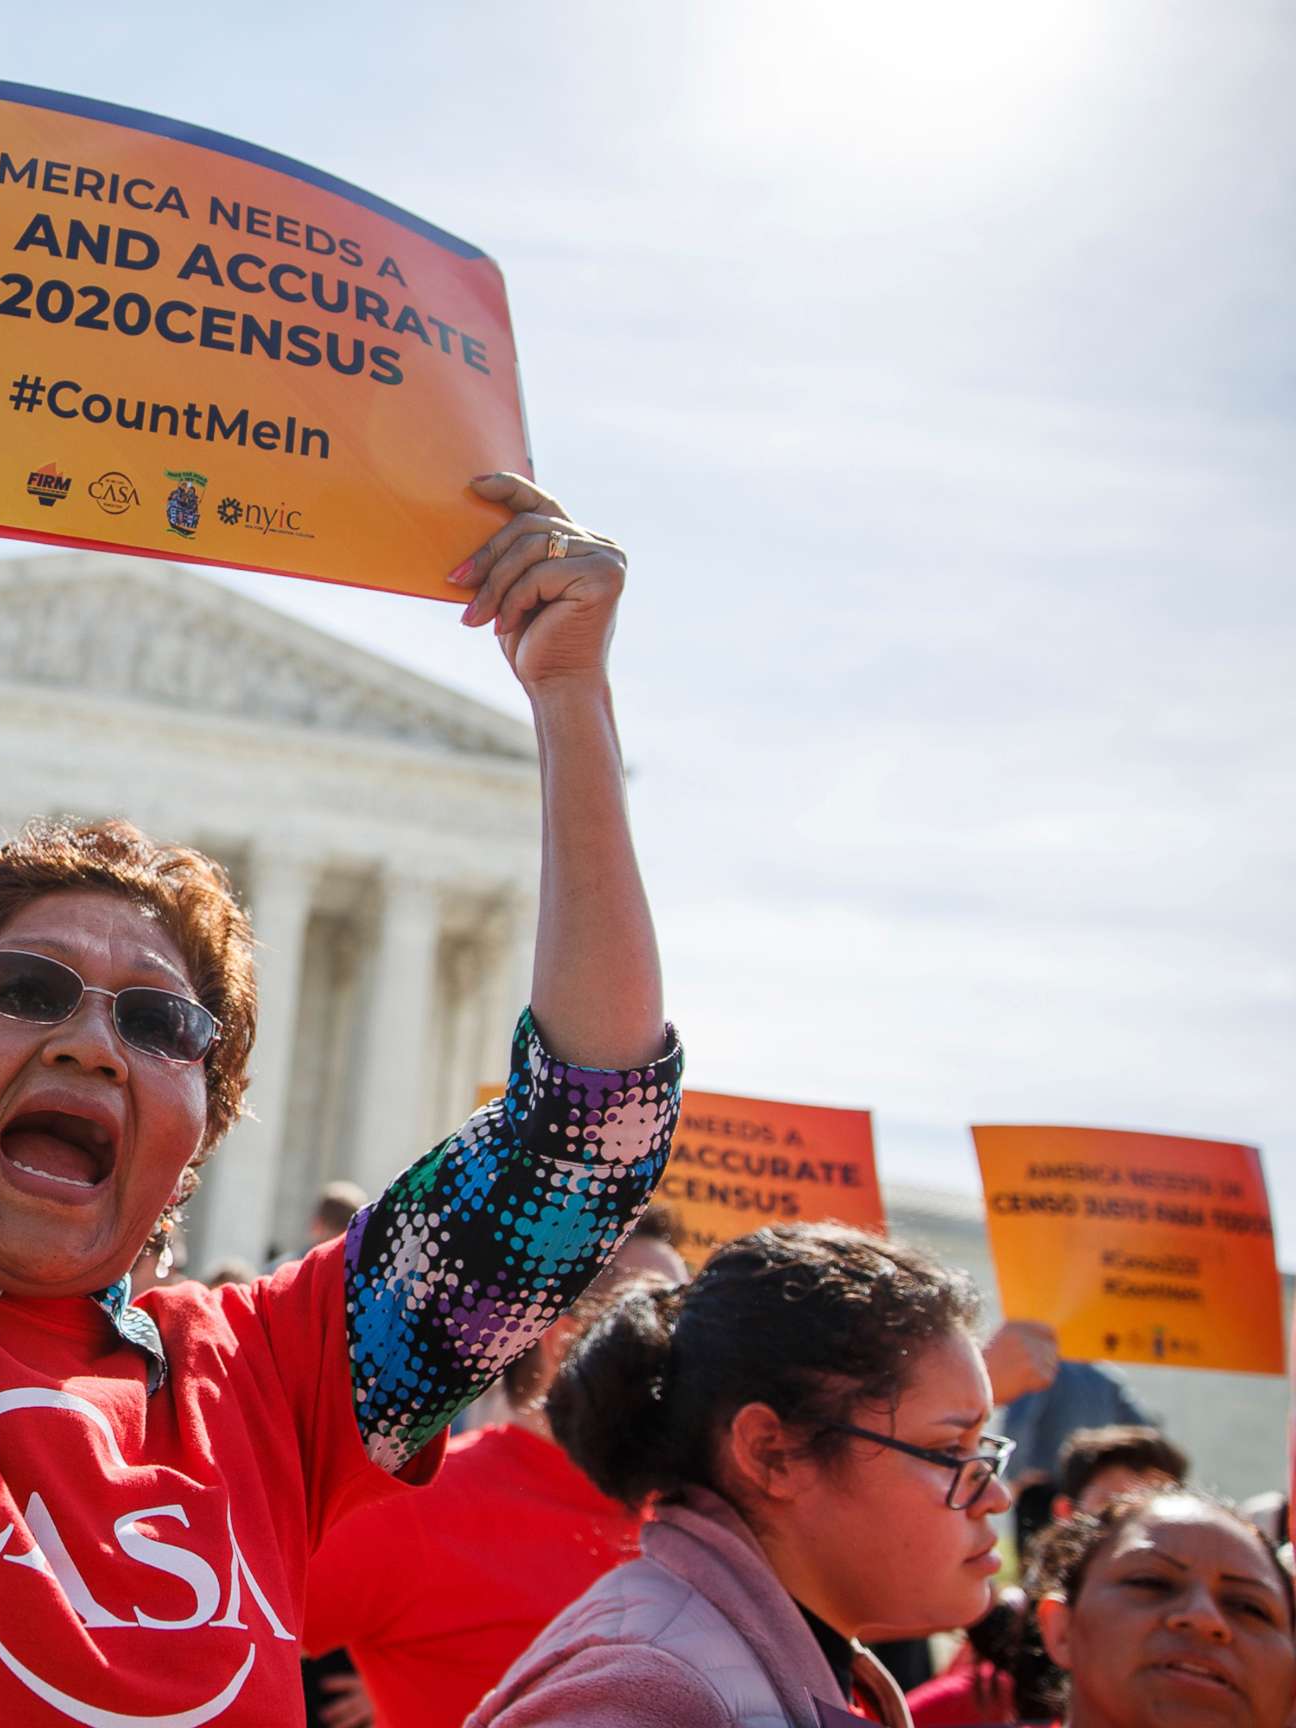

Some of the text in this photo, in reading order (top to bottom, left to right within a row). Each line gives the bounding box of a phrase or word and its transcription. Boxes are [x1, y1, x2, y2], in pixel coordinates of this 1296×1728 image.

[209, 196, 363, 267] NEEDS
[377, 255, 408, 288] A
[14, 213, 160, 271] AND
[178, 244, 491, 374] ACCURATE
[9, 374, 331, 459] #CountMeIn
[27, 472, 73, 492] FIRM
[88, 480, 141, 506] CASA
[245, 501, 303, 535] nyic
[683, 1114, 803, 1146] NEEDS A
[672, 1144, 862, 1187] ACCURATE
